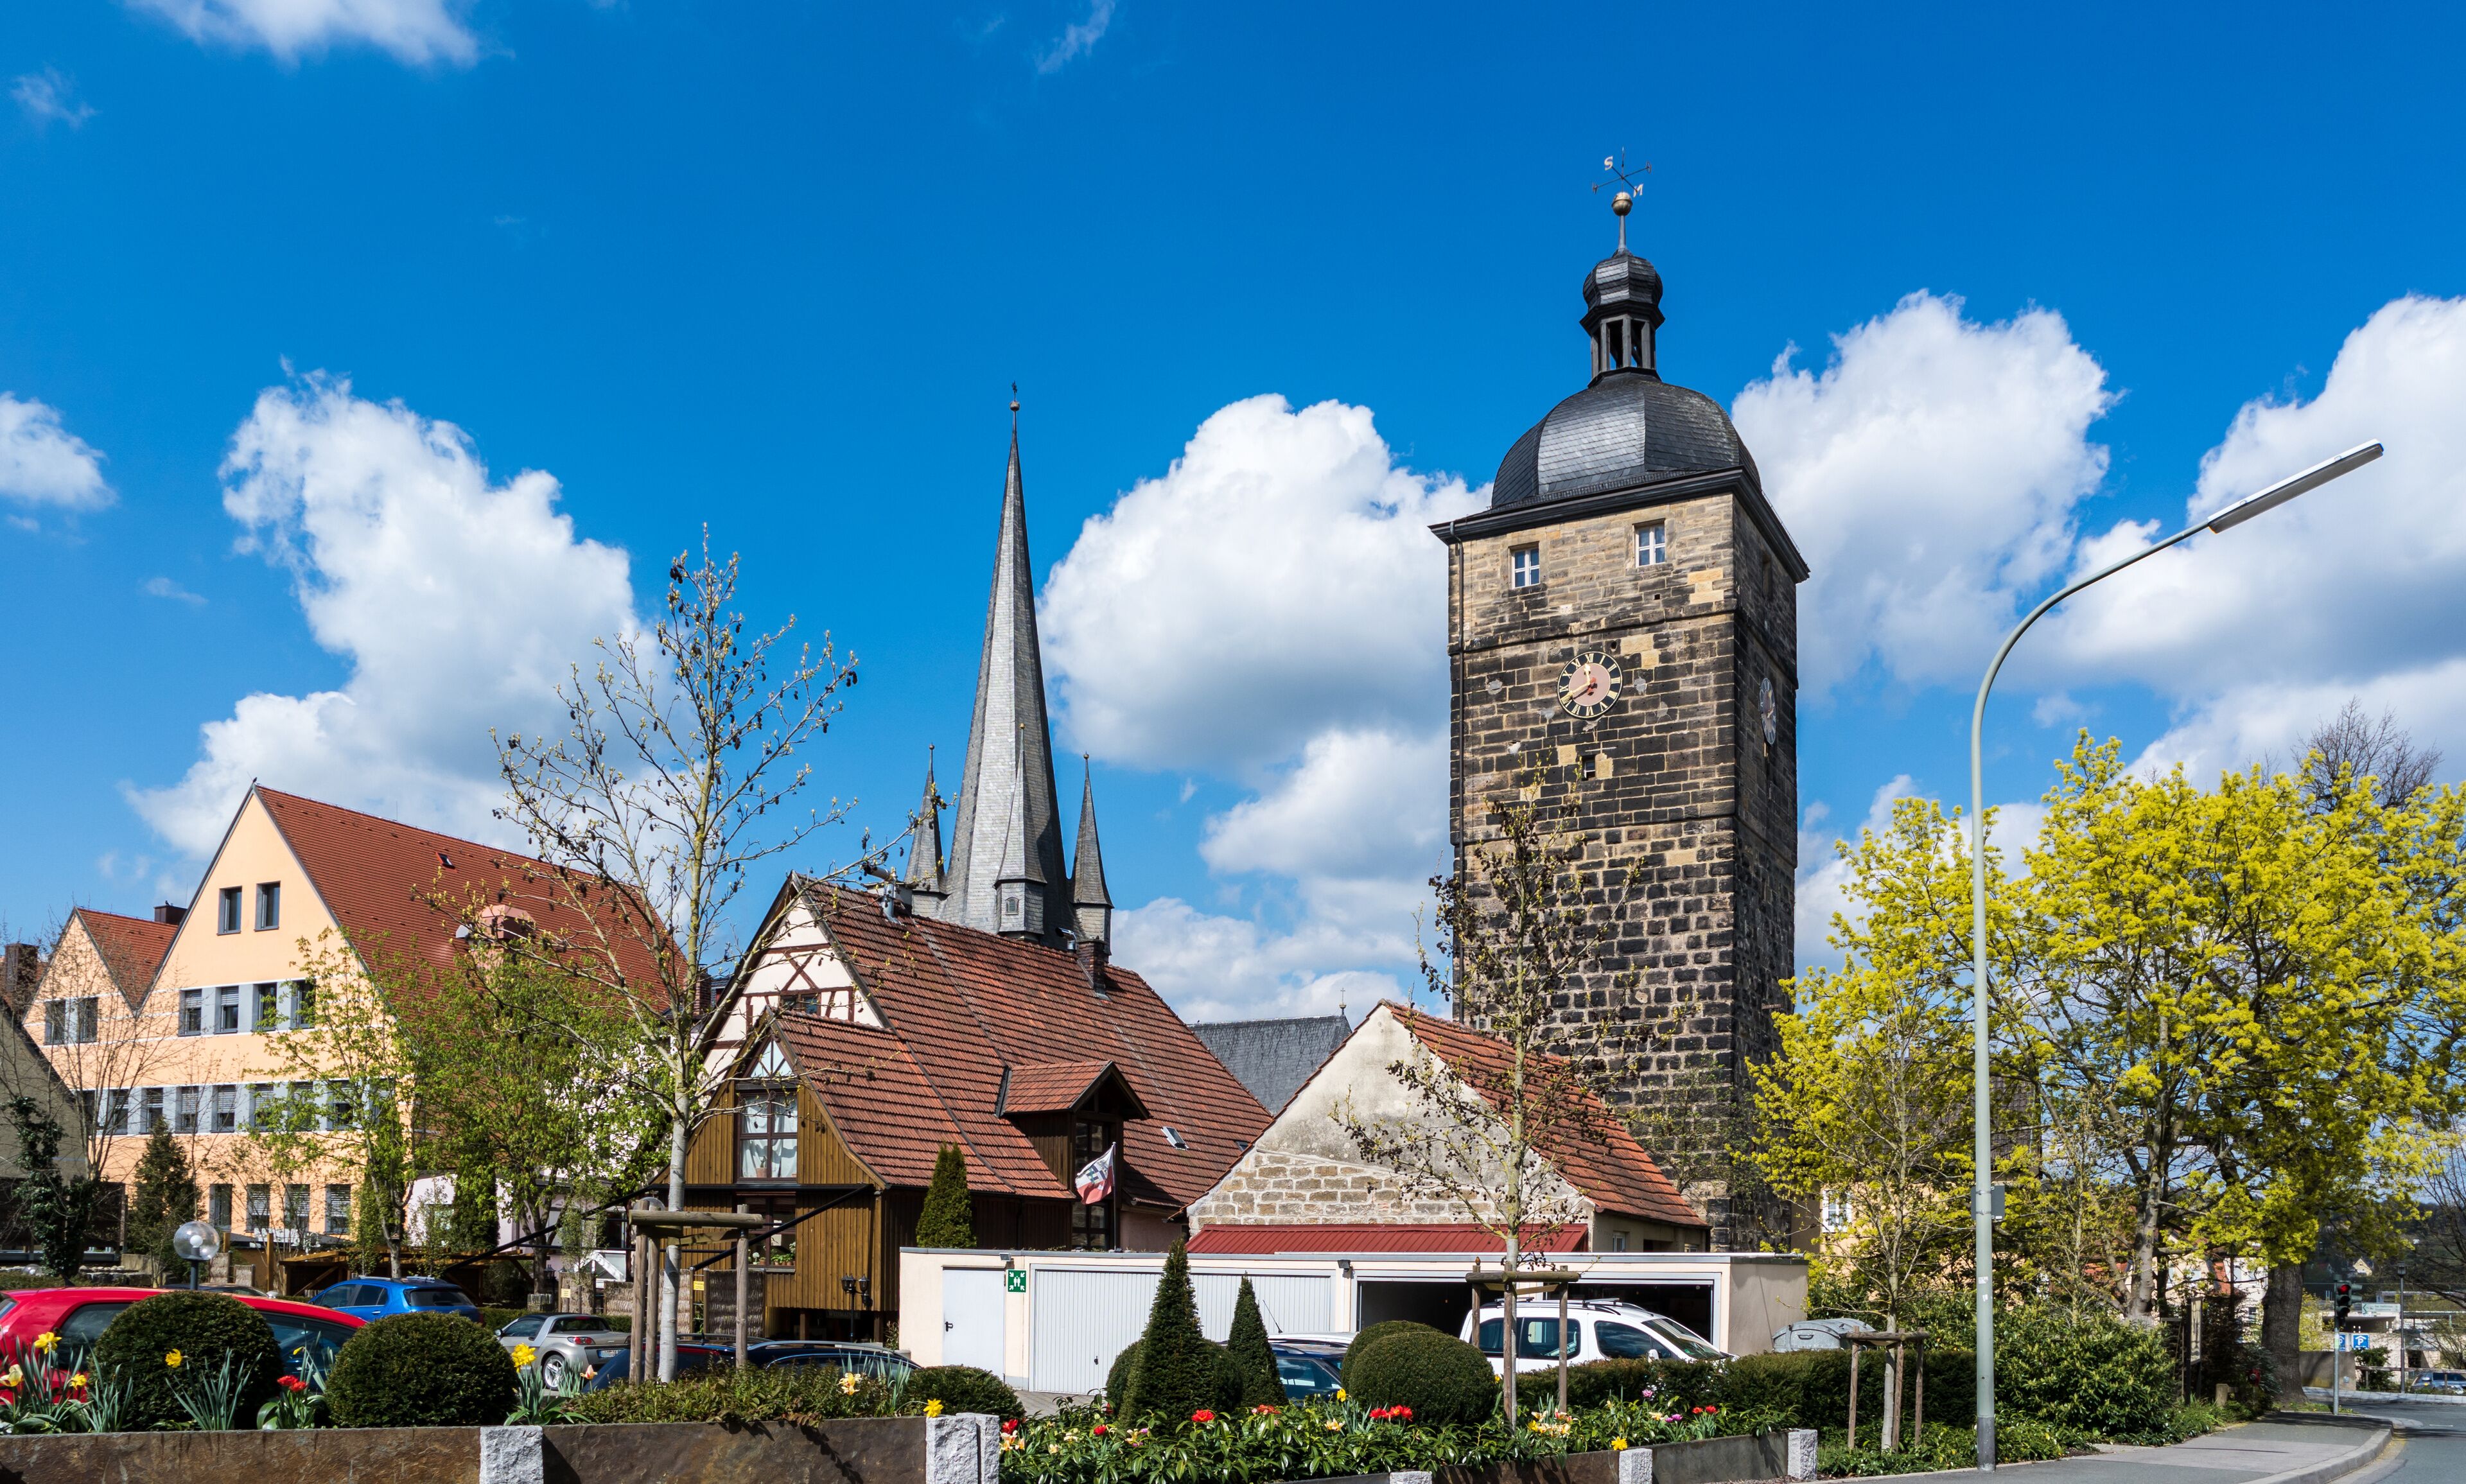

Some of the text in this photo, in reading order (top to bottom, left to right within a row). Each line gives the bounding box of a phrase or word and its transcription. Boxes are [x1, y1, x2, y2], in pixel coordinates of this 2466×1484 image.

[1604, 155, 1613, 171] S
[1584, 653, 1594, 663] XII
[1599, 655, 1606, 665] I
[1607, 663, 1617, 672] II
[1562, 670, 1573, 679] X
[1600, 701, 1608, 712] V
